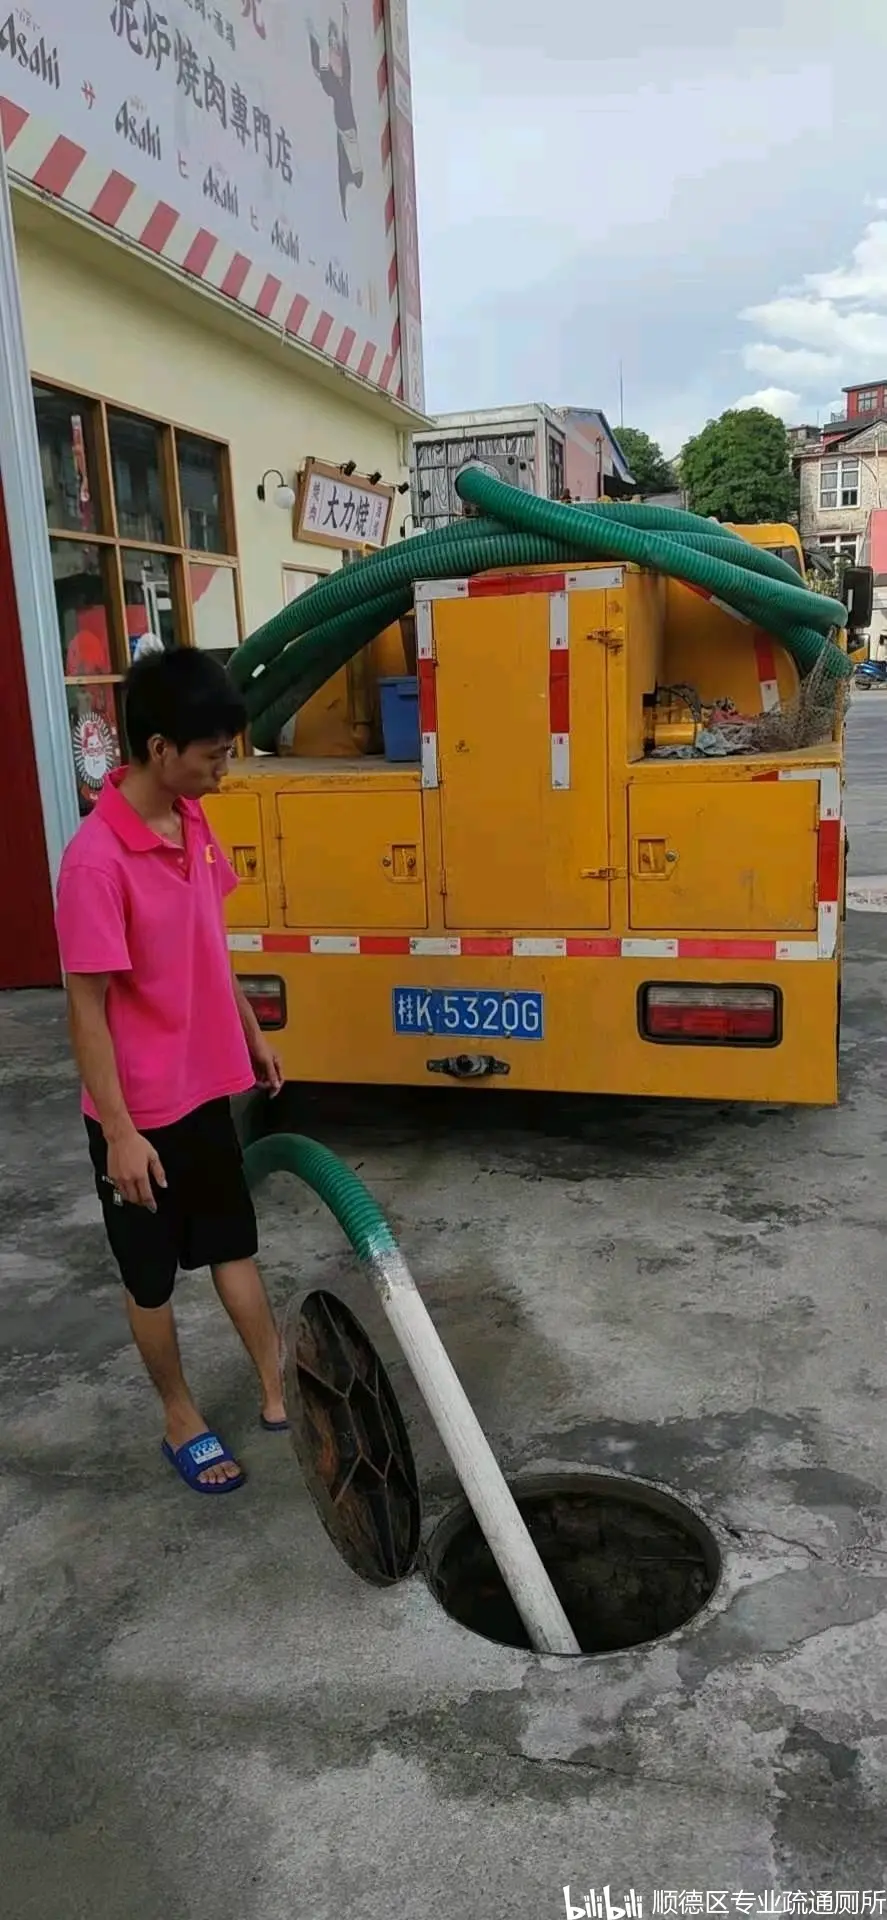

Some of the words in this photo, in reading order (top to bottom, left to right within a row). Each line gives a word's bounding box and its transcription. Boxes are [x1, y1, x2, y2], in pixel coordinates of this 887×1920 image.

[0, 12, 60, 90] Asahi
[115, 100, 161, 161] Asahi
[203, 166, 239, 218] Asahi
